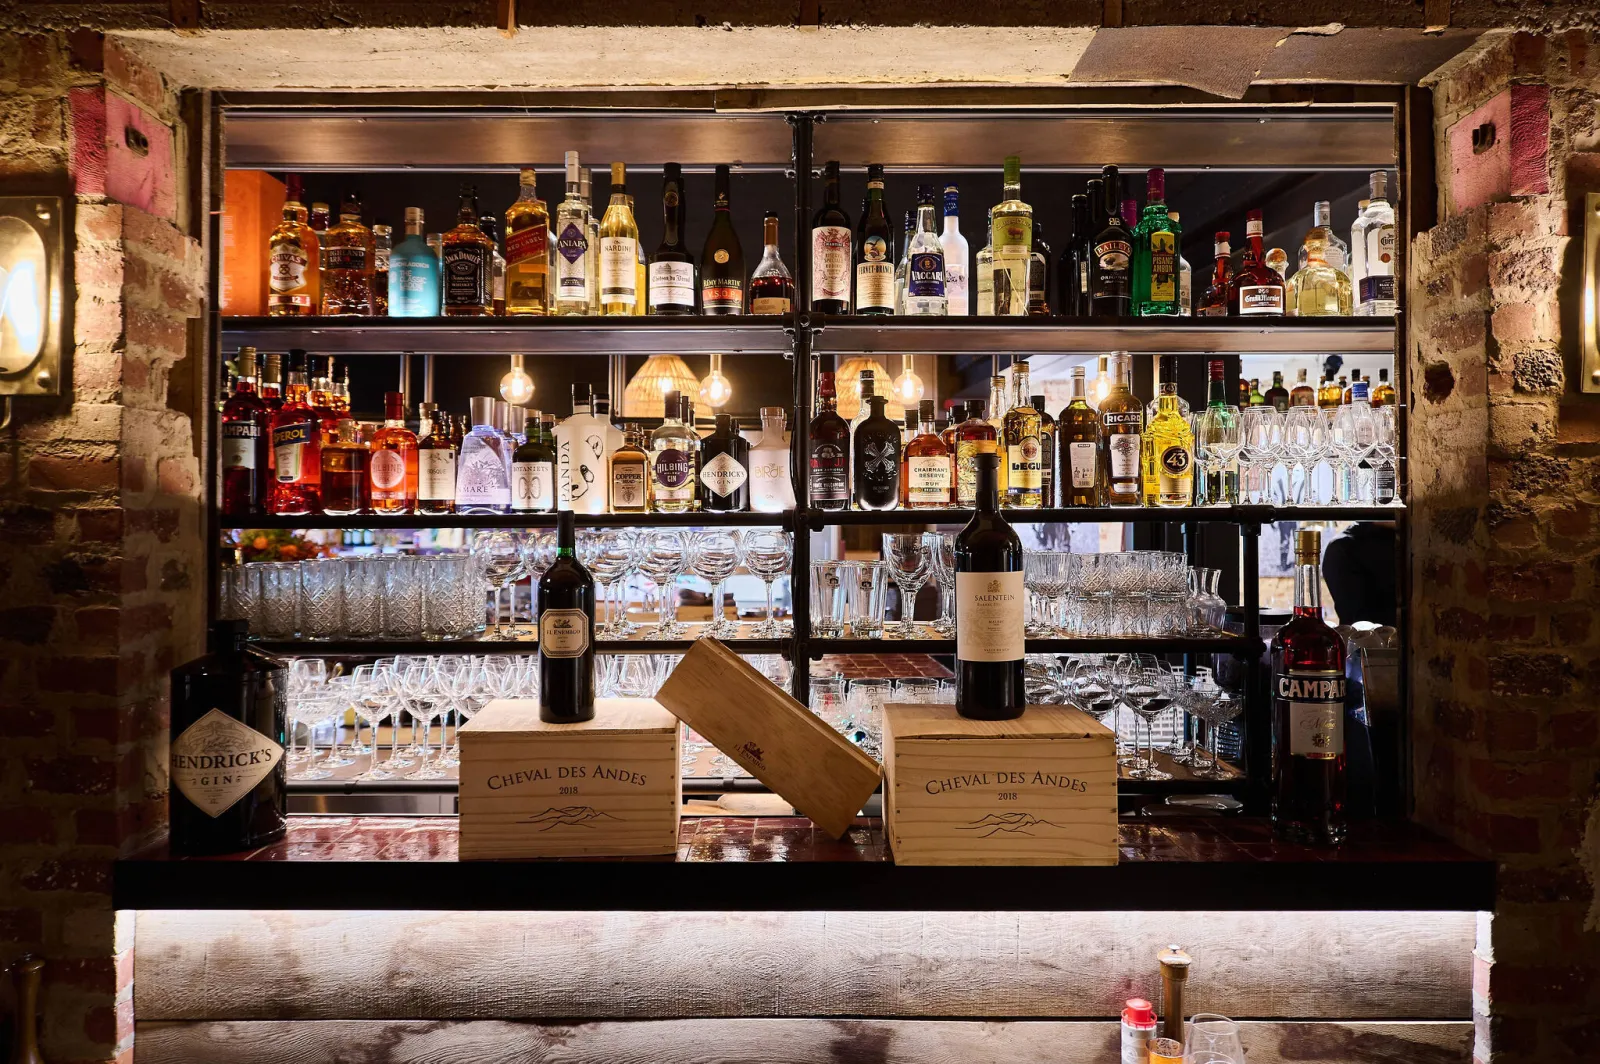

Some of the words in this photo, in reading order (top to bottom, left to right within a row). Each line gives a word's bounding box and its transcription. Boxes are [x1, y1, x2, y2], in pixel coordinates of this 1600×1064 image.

[520, 236, 544, 246] LABEL
[1380, 236, 1395, 246] Cuer
[1096, 242, 1131, 254] BAILEYS
[271, 253, 301, 264] CHIVAS
[444, 253, 459, 265] JACK
[1152, 256, 1174, 265] PISANG
[1152, 264, 1174, 273] AMBON
[911, 271, 944, 282] VACCARI
[717, 278, 741, 287] MARTIN
[291, 296, 301, 304] 12
[1107, 413, 1141, 423] RICARD
[223, 425, 261, 437] AMPARI
[1166, 452, 1187, 467] 43
[560, 440, 570, 502] PANDA
[656, 462, 688, 474] HILBING
[1011, 462, 1041, 471] LEGU
[702, 470, 745, 478] HENDRICK'S
[974, 594, 1015, 602] SALENTEIN
[1278, 676, 1346, 700] CAMPAR
[171, 748, 272, 770] HENDRICK'S
[200, 775, 233, 786] GIN
[486, 767, 552, 790] CHEVAL
[557, 766, 587, 779] DES
[592, 764, 647, 787] ANDES
[925, 772, 991, 795] CHEVAL
[996, 771, 1026, 785] DES
[1030, 769, 1088, 793] ANDES
[558, 786, 579, 795] 2018
[997, 792, 1018, 801] 2018
